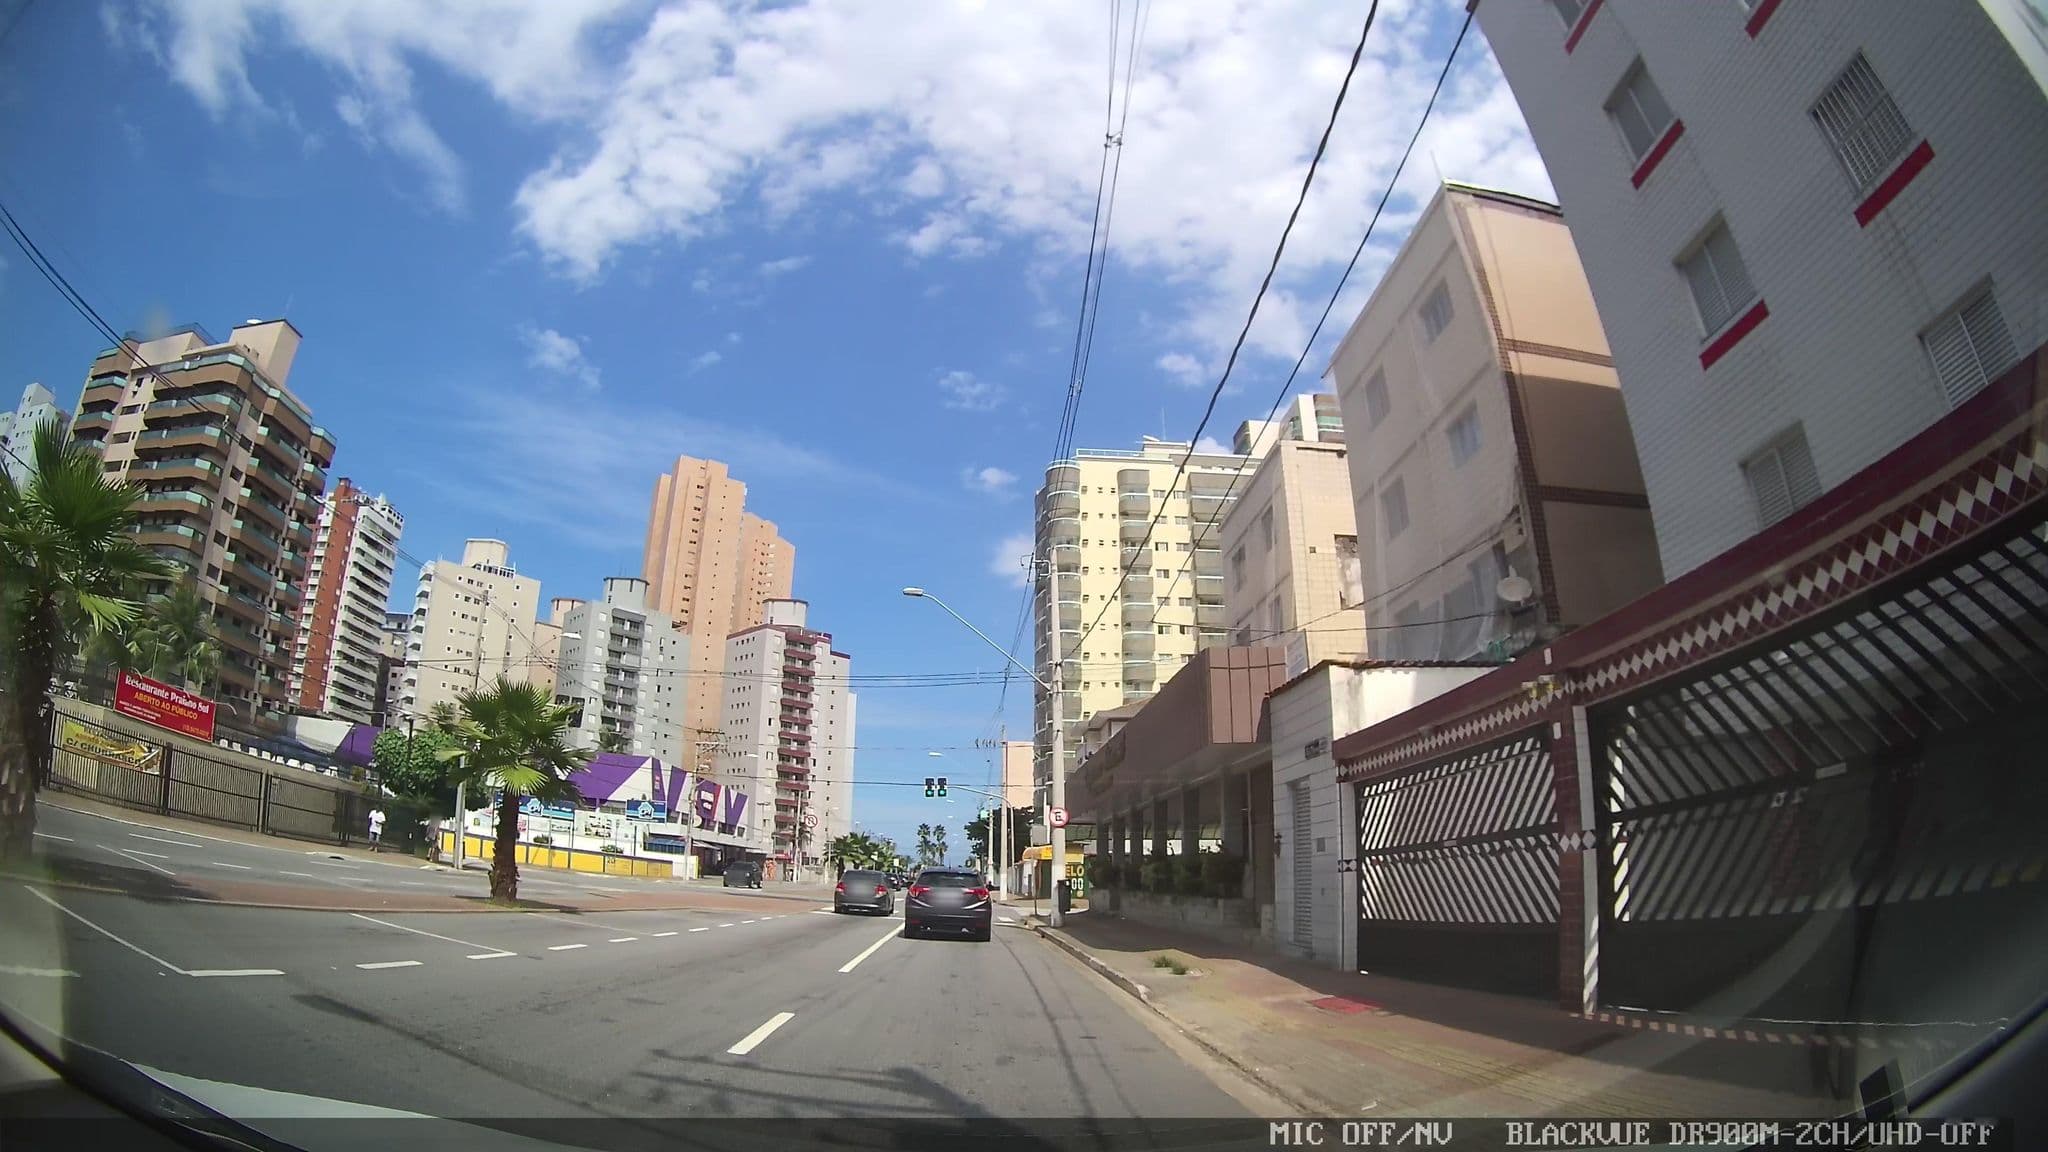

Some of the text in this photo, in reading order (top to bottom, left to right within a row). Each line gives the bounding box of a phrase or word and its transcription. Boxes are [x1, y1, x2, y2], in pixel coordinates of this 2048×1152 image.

[134, 692, 160, 707] ABERTO
[161, 701, 171, 711] AO
[197, 702, 210, 714] Sul
[1065, 864, 1084, 877] ELO
